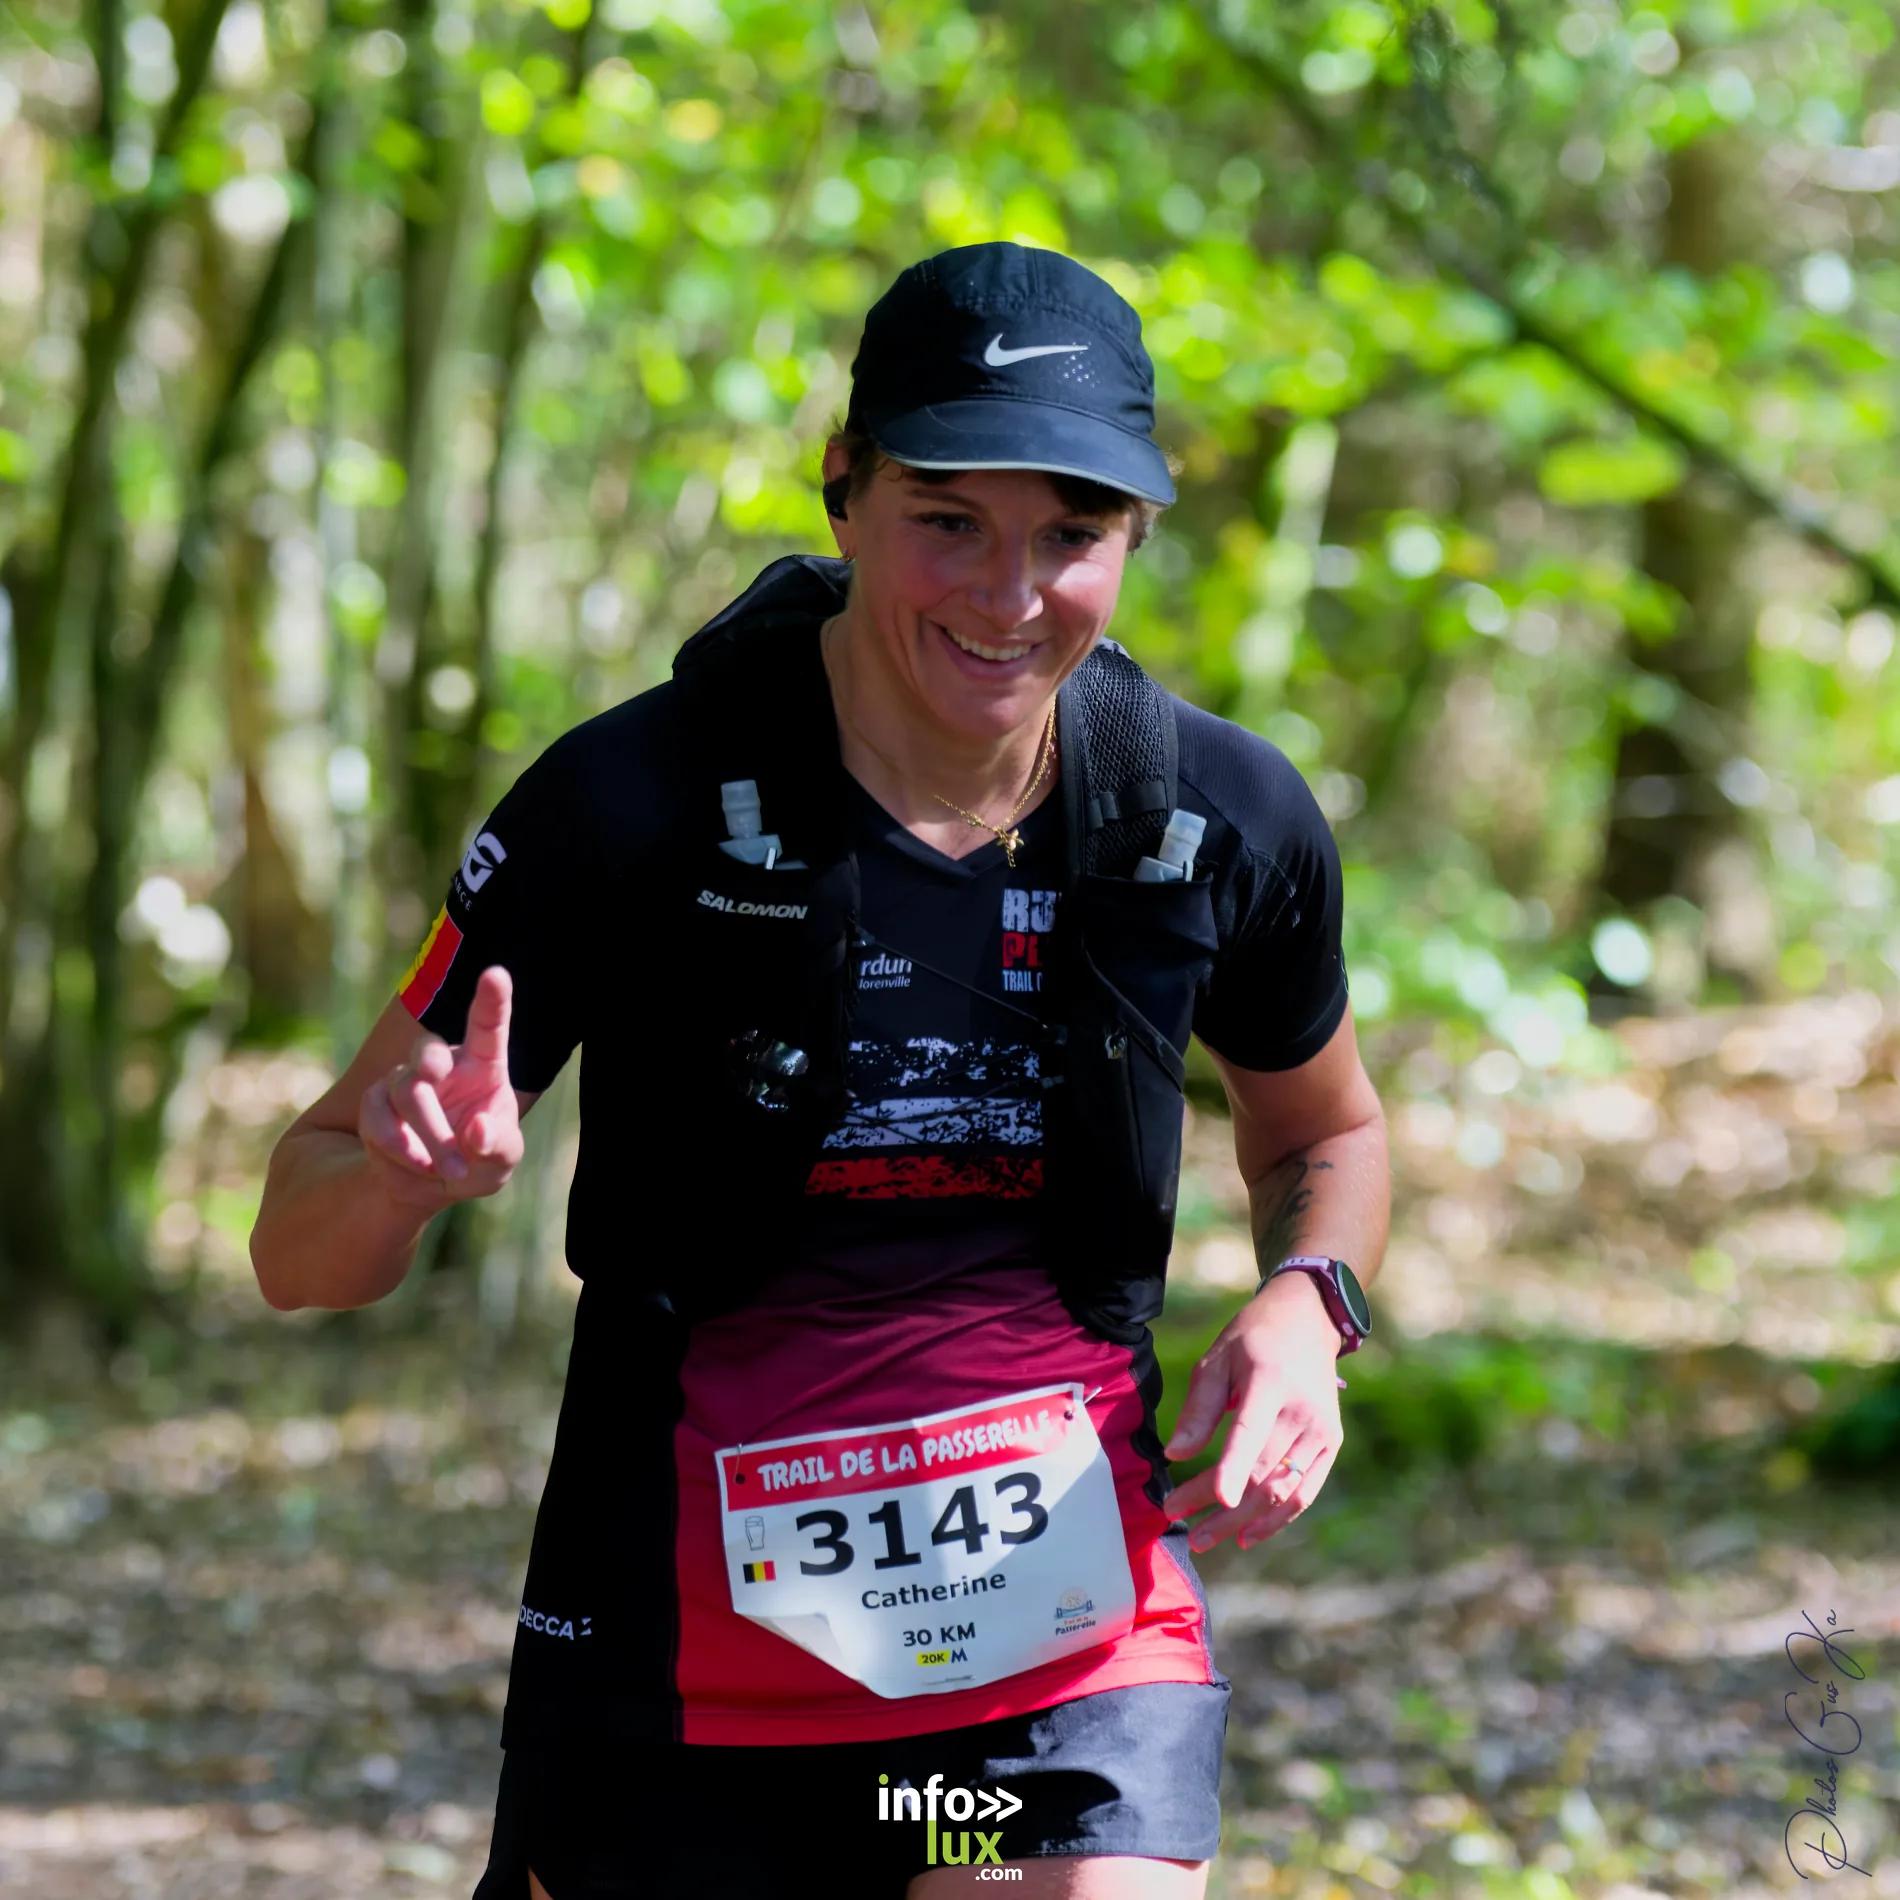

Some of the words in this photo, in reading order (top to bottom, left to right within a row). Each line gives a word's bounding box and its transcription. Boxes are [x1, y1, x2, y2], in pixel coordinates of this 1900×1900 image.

[697, 889, 808, 920] SALOMON
[860, 952, 913, 977] rdun
[858, 975, 911, 990] lorenville
[1001, 969, 1034, 992] TRAIL
[757, 1456, 835, 1492] TRAIL
[840, 1448, 875, 1479] DE
[881, 1443, 917, 1473] LA
[922, 1409, 1052, 1467] PASSERELLE
[795, 1471, 1050, 1577] 3143
[861, 1572, 1007, 1610] Catherine
[902, 1629, 933, 1647] 30
[940, 1621, 976, 1643] KM
[921, 1652, 945, 1664] 20K
